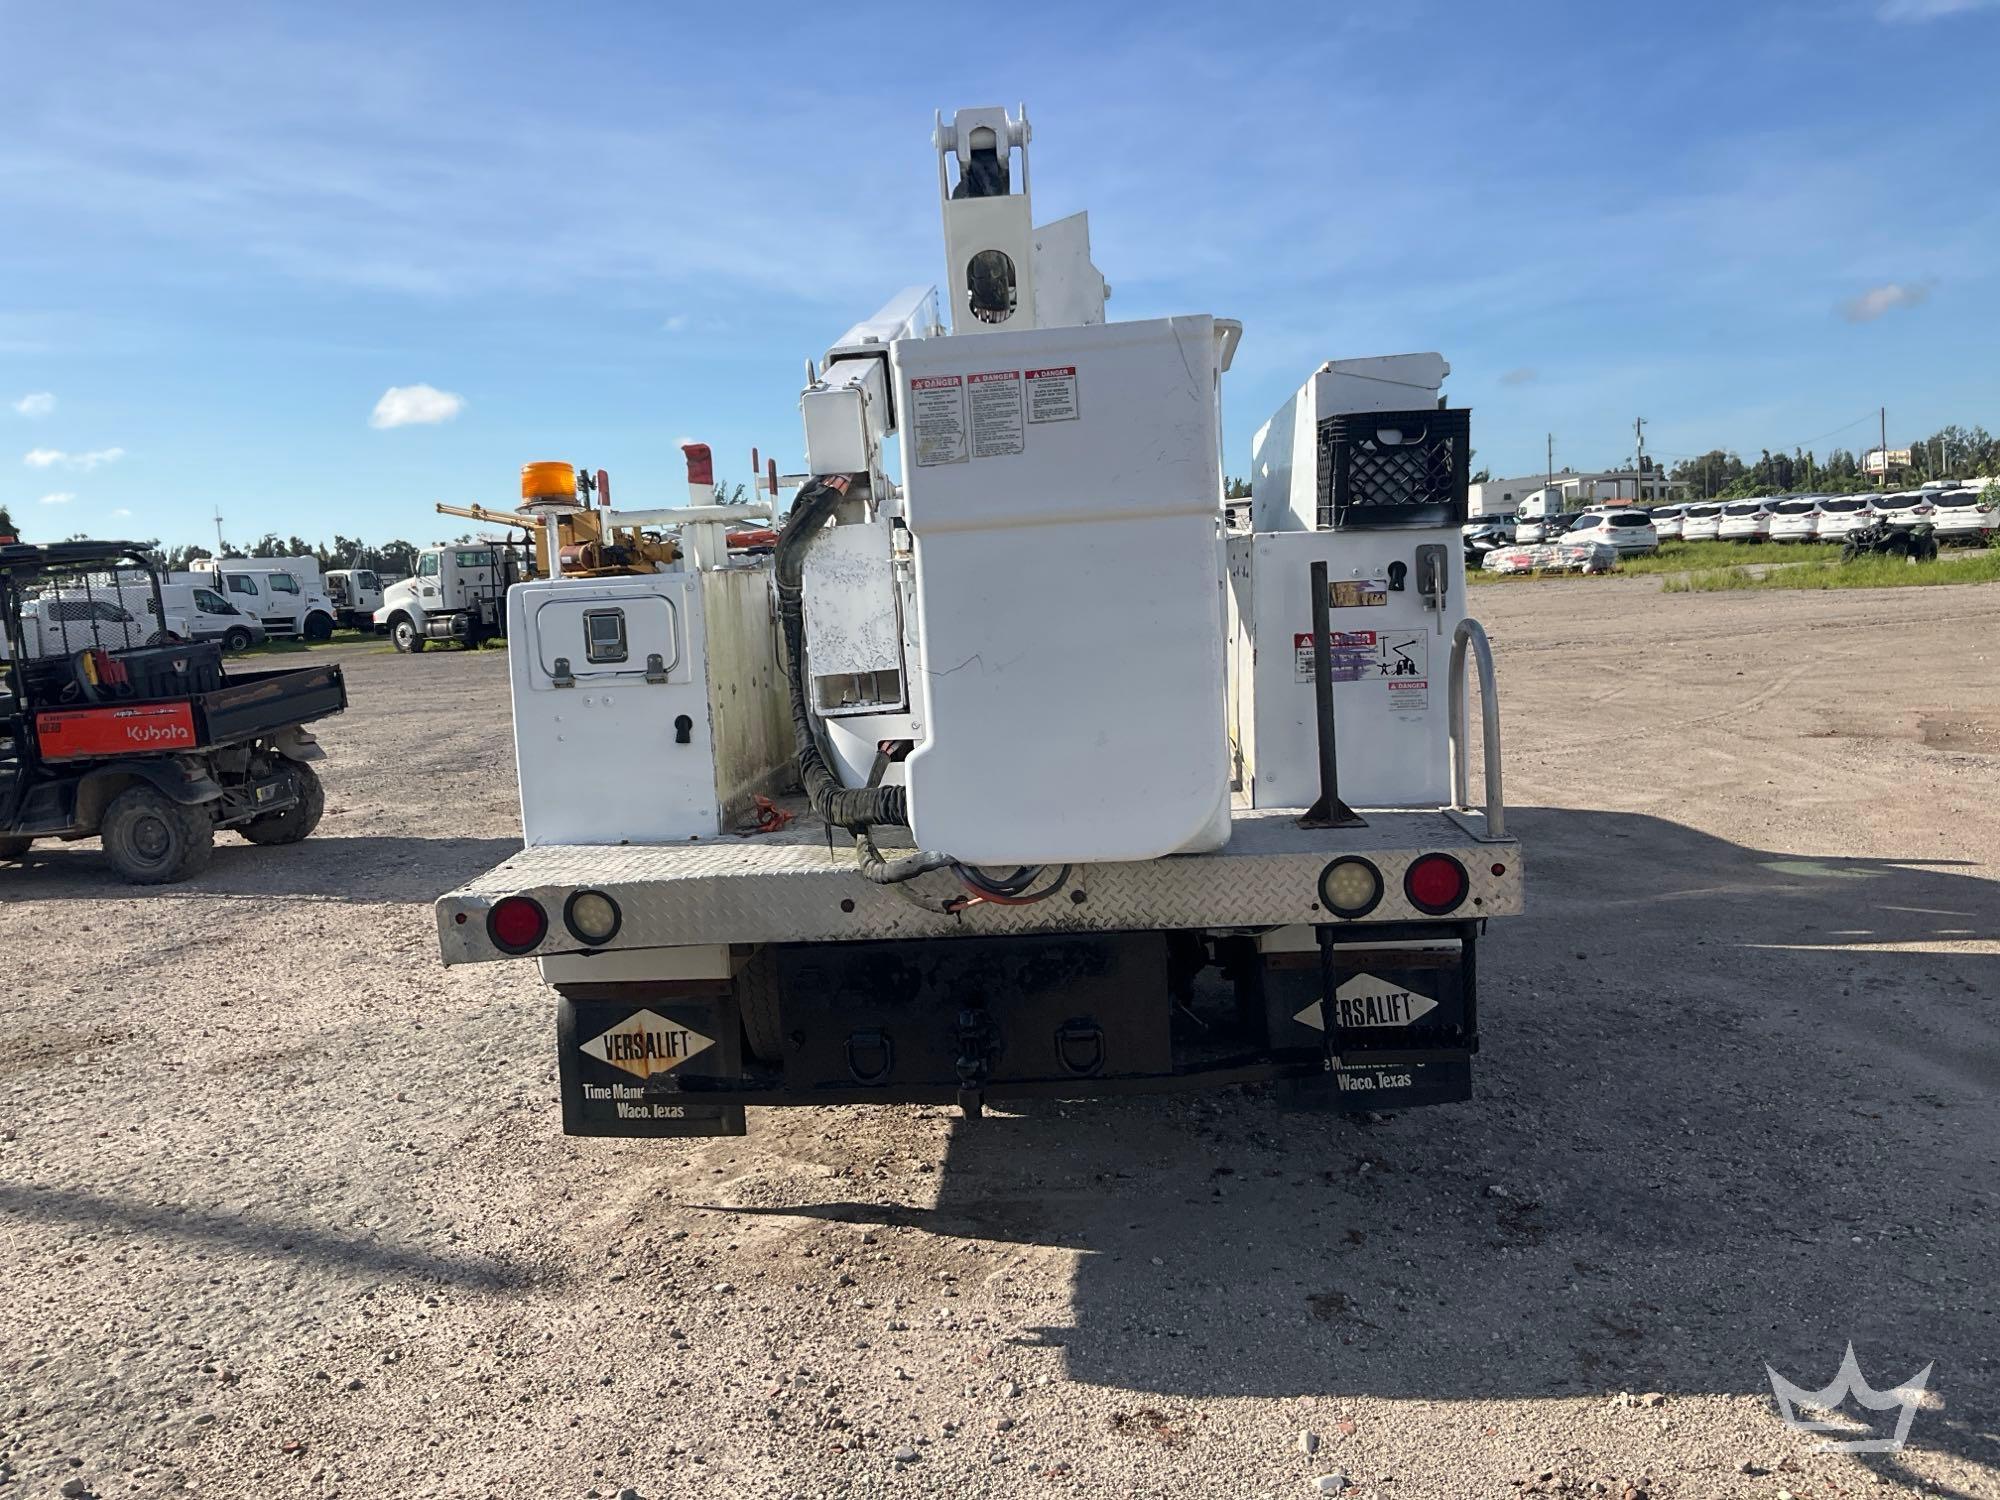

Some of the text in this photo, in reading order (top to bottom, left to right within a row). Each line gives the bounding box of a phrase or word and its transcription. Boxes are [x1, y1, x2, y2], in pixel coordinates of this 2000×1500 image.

[982, 373, 1014, 382] DANGER
[1041, 368, 1069, 377] DANGER
[924, 378, 960, 389] DANGER
[1398, 682, 1426, 690] DANGER
[126, 723, 189, 742] Kubota
[603, 1030, 690, 1061] VERSALIFT
[1376, 1071, 1412, 1089] Texas
[582, 1083, 612, 1100] Time
